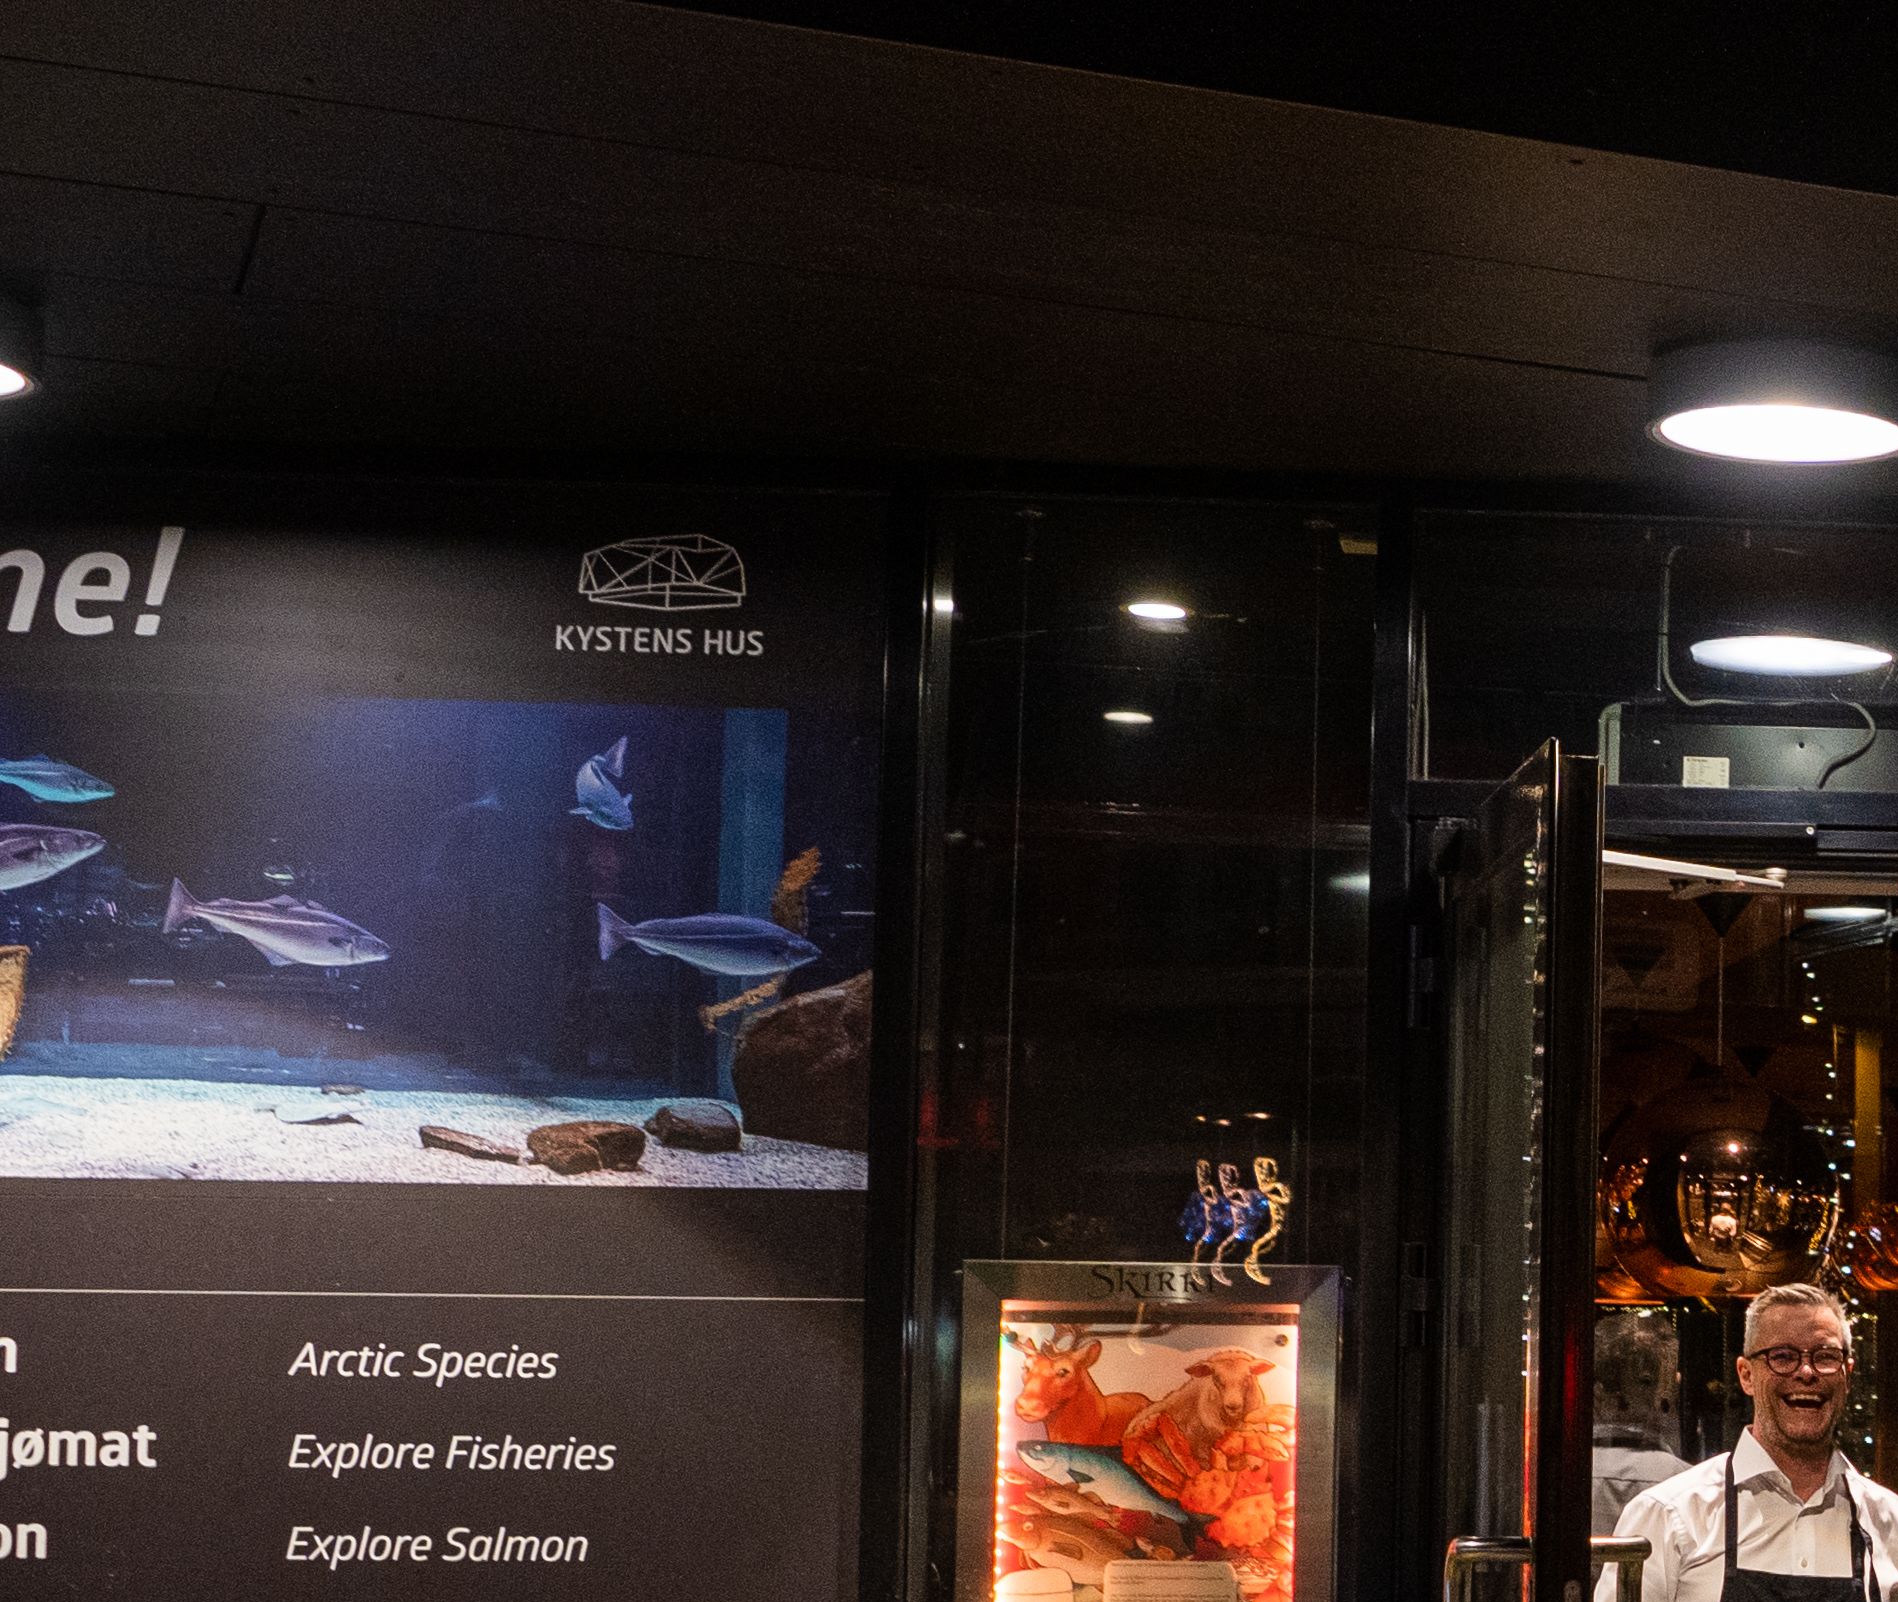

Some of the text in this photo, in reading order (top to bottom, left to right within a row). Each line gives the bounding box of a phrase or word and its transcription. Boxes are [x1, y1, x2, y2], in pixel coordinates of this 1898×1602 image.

[555, 624, 764, 656] KYSTENS HUS
[288, 1343, 559, 1387] Arctic Species
[288, 1434, 617, 1478] Explore Fisheries
[285, 1526, 589, 1571] Explore Salmon
